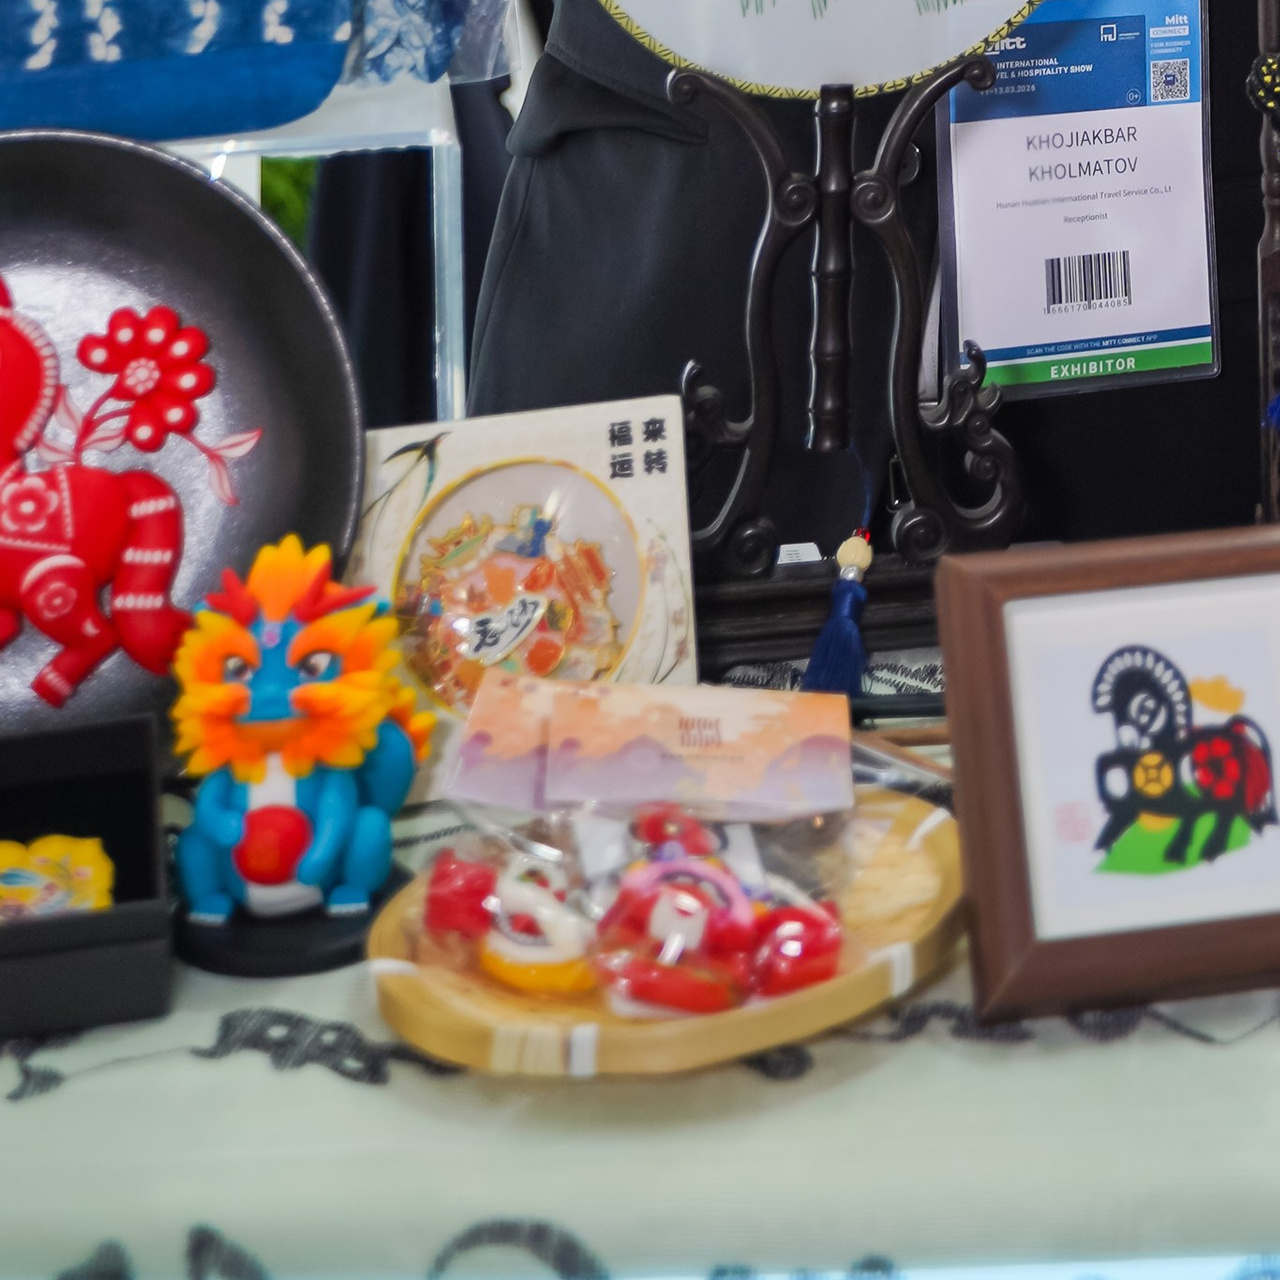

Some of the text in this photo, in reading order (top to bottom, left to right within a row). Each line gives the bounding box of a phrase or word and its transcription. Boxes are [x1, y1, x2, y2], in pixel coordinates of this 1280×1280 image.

[1165, 14, 1189, 25] Mitt
[996, 58, 1059, 70] INTERNATIONAL
[1018, 66, 1069, 78] HOSPITALITY
[1069, 64, 1093, 74] SHOW
[1128, 92, 1139, 101] 0+
[1026, 126, 1138, 151] KHOJIAKBAR
[1029, 156, 1138, 183] KHOLMATOV
[996, 201, 1021, 210] Hunan
[1051, 192, 1099, 204] International
[1100, 189, 1122, 200] Travel
[1123, 187, 1149, 197] Service
[1149, 186, 1164, 195] Co.,
[1165, 185, 1172, 193] Lt
[1063, 212, 1109, 224] Receptionist
[1091, 298, 1128, 310] 044085
[1026, 347, 1043, 356] SCAN
[1044, 346, 1056, 354] THE
[1056, 344, 1073, 352] CODE
[1074, 342, 1089, 350] WITH
[1090, 341, 1101, 349] THE
[1117, 336, 1146, 345] CONNECT
[1050, 357, 1136, 379] EXHIBITOR
